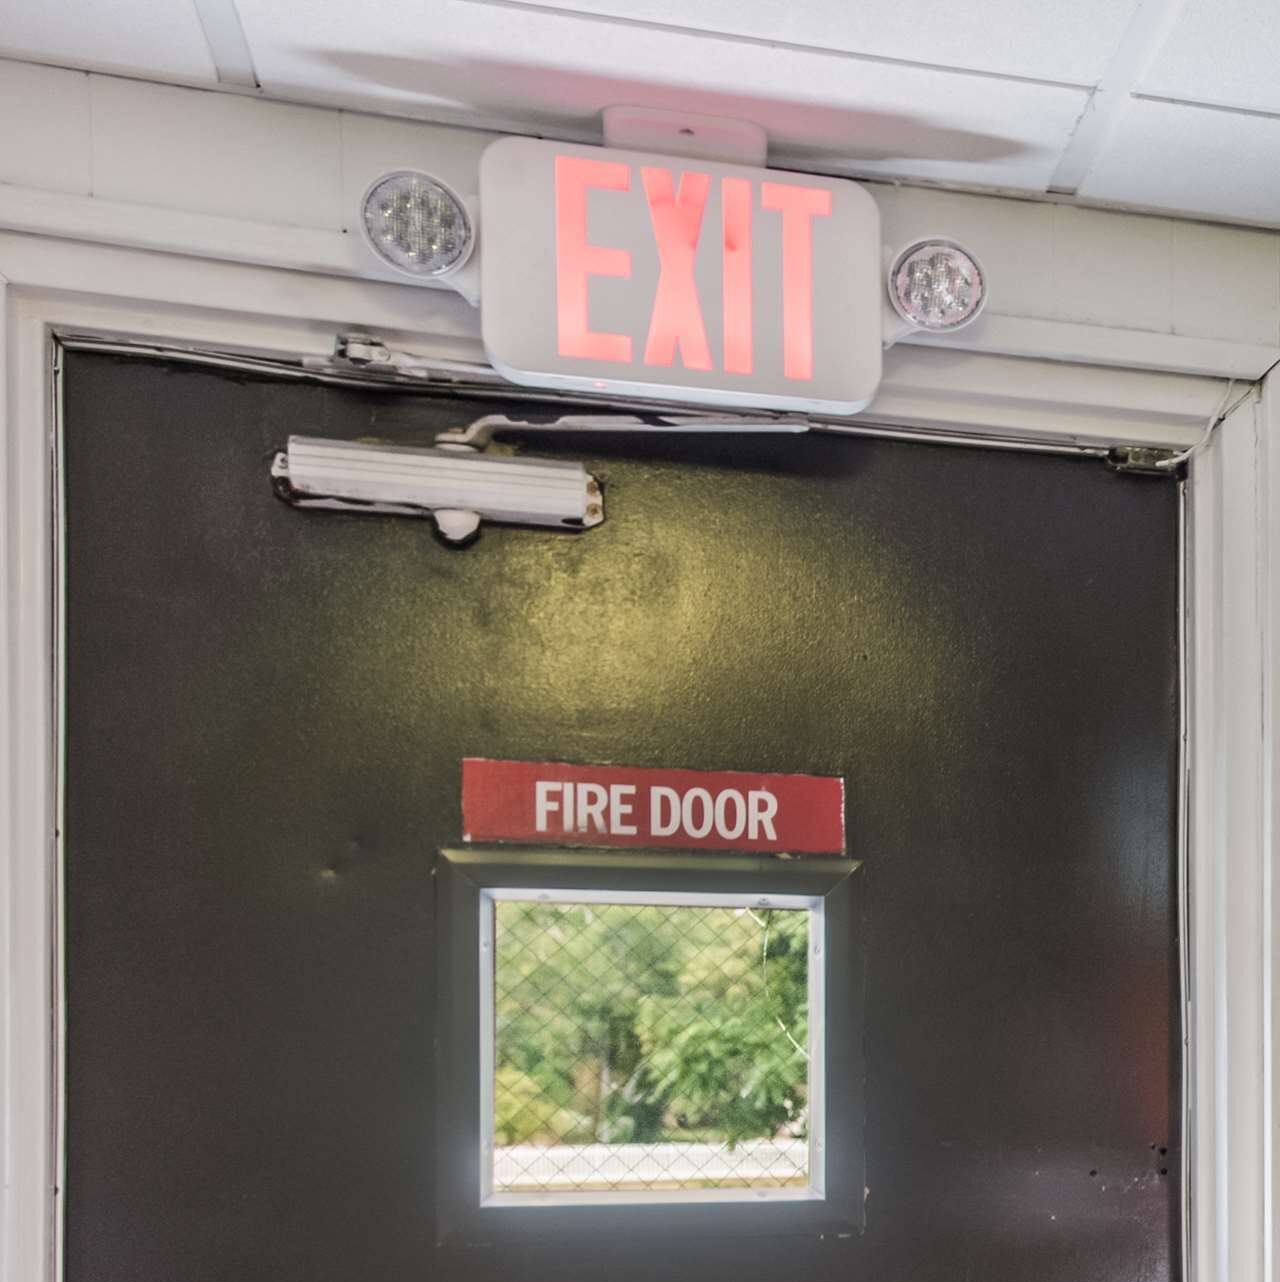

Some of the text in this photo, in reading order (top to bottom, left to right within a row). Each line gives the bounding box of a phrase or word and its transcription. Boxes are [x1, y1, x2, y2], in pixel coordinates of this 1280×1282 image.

[554, 155, 833, 381] EXIT
[535, 780, 778, 841] FIRE DOOR
